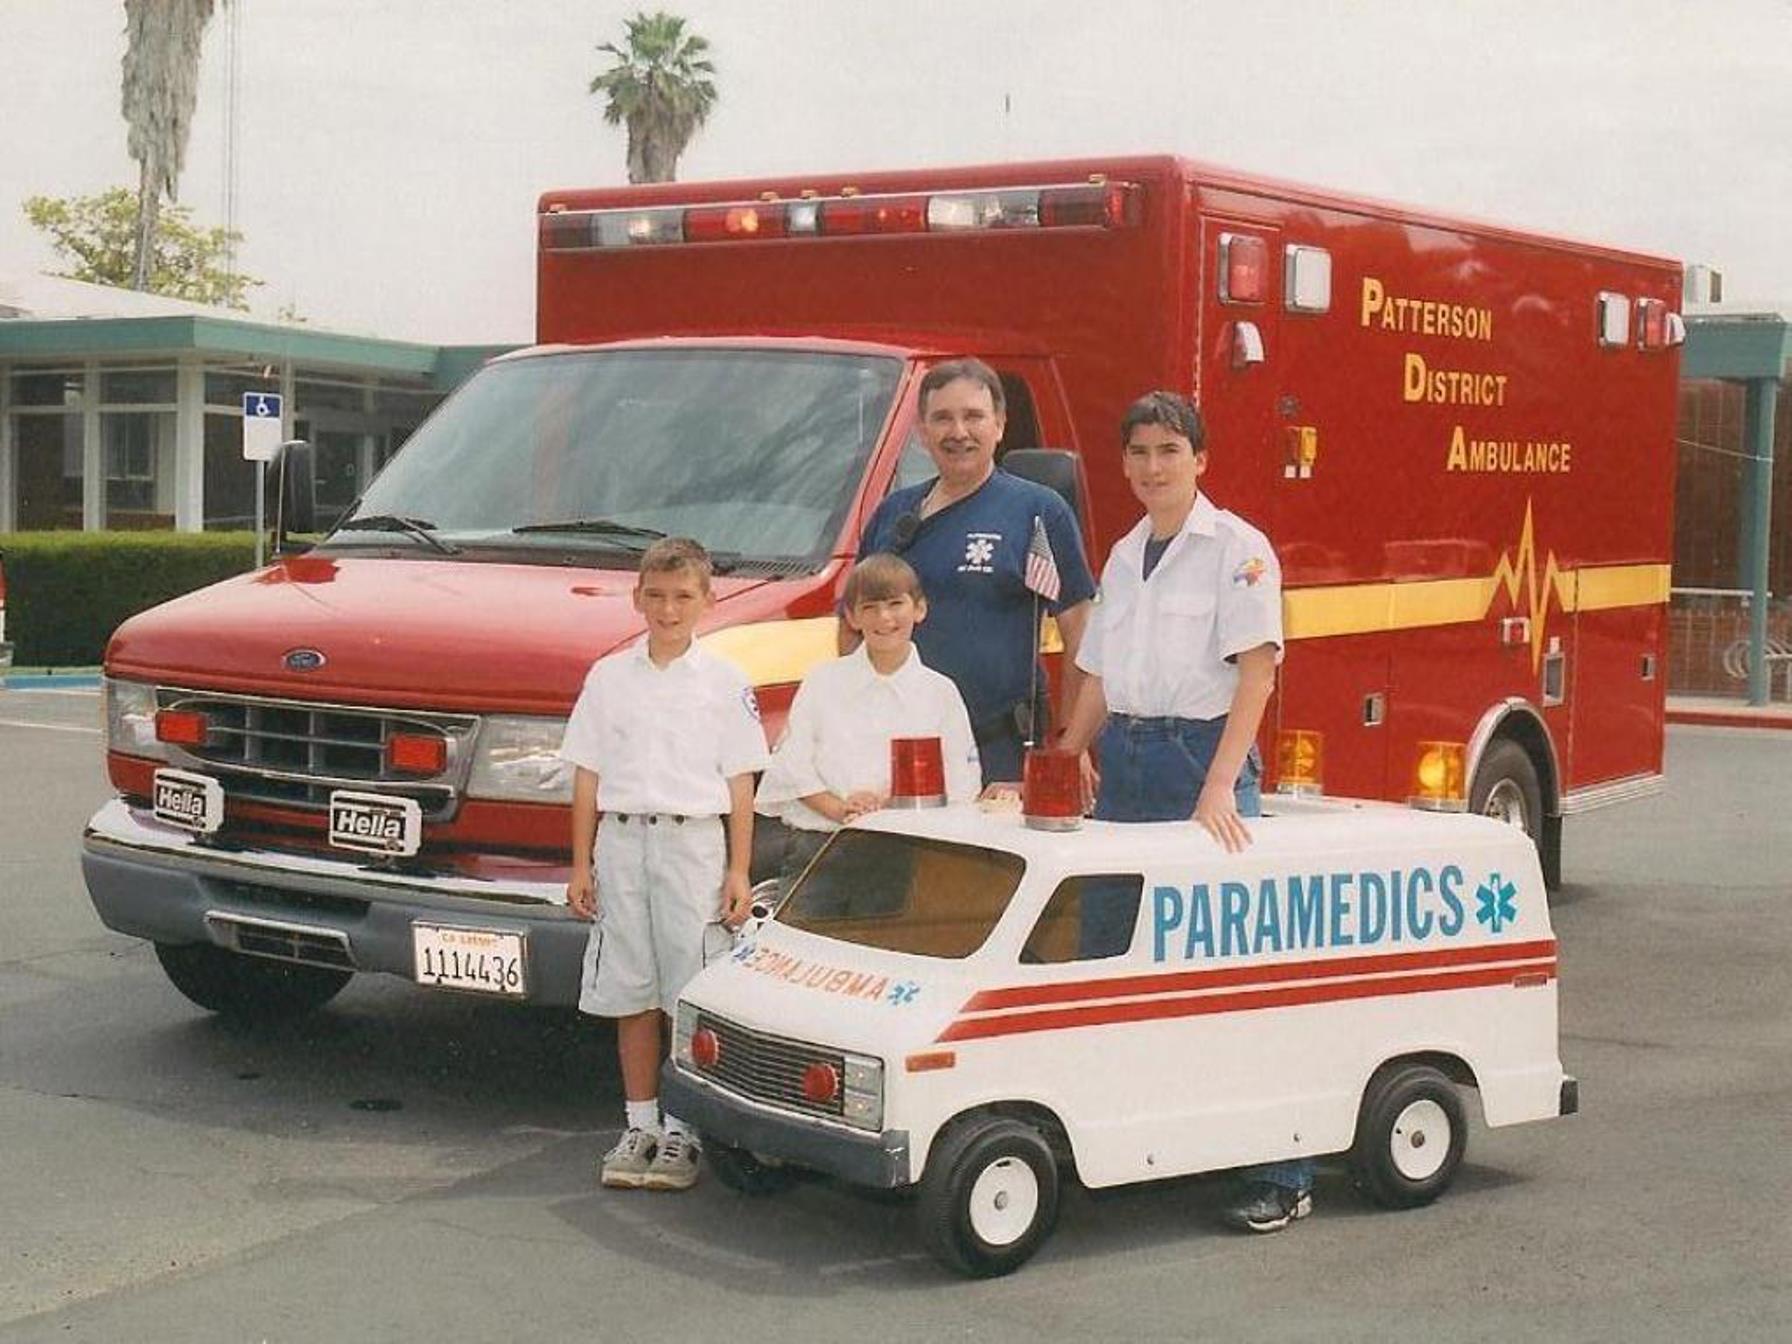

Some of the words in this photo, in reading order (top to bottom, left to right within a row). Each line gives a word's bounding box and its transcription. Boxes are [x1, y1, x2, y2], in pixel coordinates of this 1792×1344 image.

[1361, 277, 1493, 341] PATTERSON
[1404, 353, 1508, 406] DISTRICT
[1447, 425, 1572, 472] AMBULANCE
[159, 786, 203, 816] Hella
[337, 810, 402, 838] Hella
[1153, 865, 1466, 963] PARAMEDICS
[423, 946, 519, 987] 1114436
